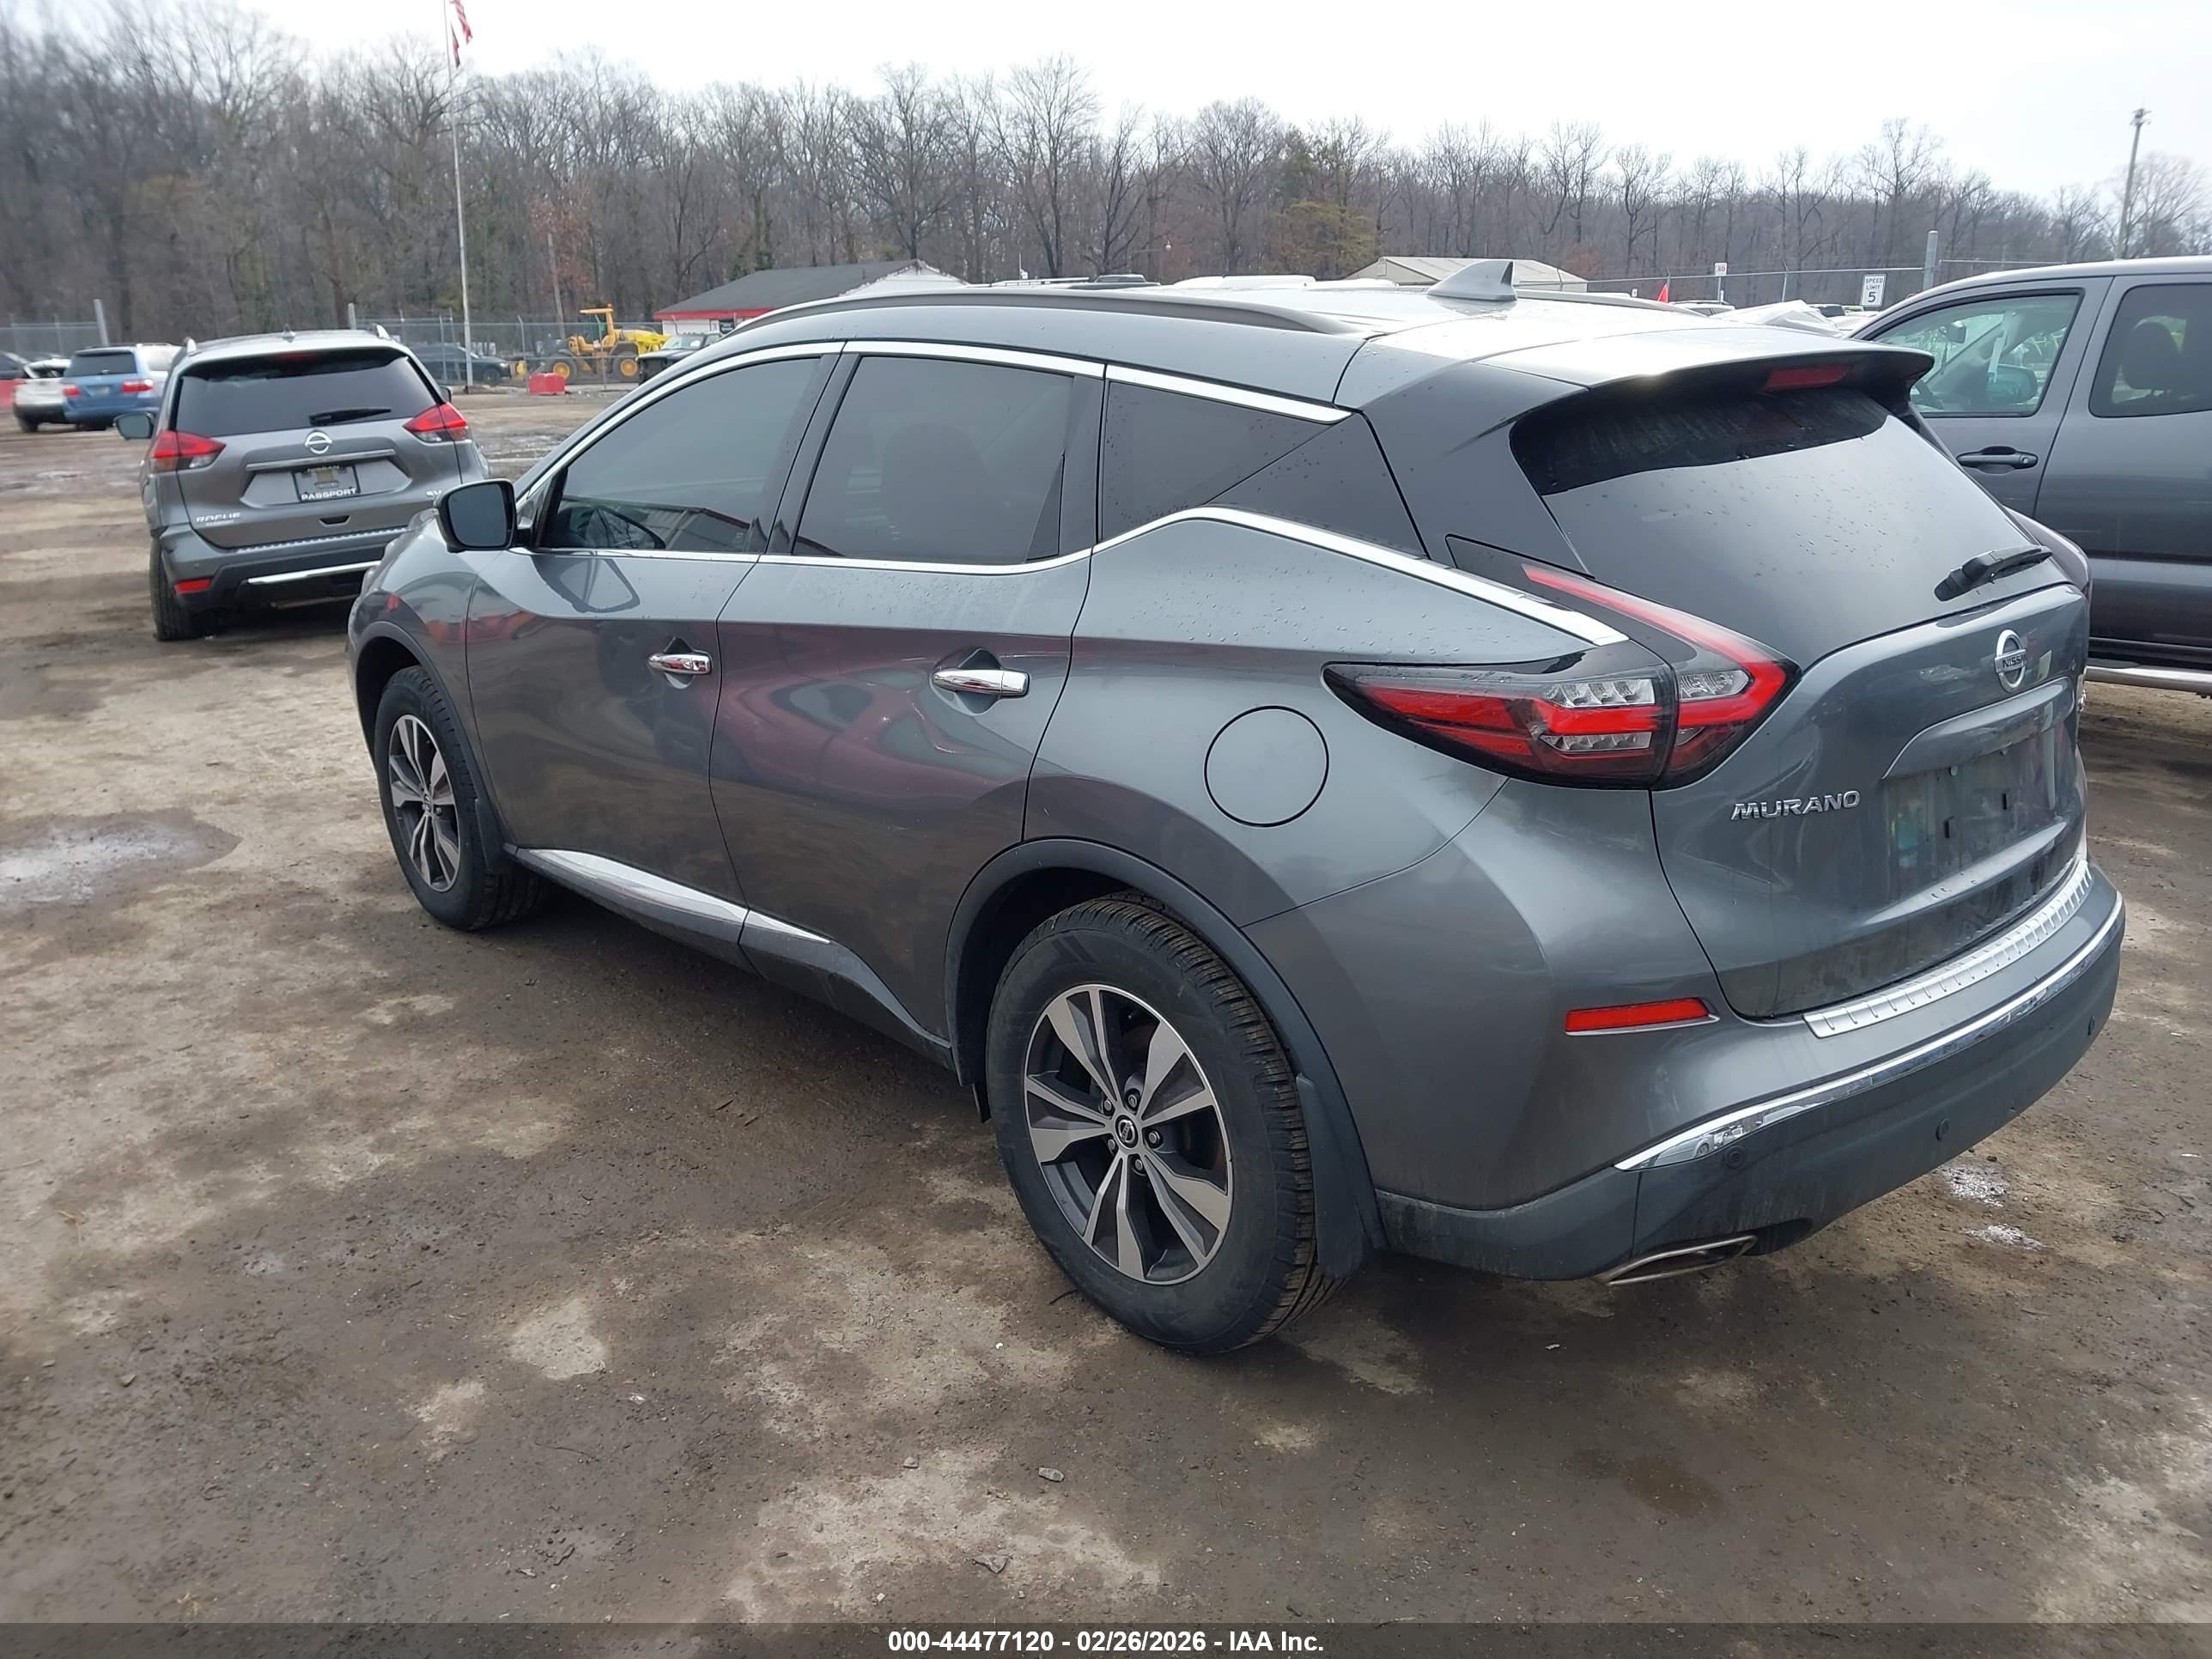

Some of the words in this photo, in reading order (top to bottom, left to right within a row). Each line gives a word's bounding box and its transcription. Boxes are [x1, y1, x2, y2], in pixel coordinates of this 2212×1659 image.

[1868, 291, 1876, 303] 5
[301, 487, 357, 501] PASSPORT
[1730, 790, 1861, 821] MURANO
